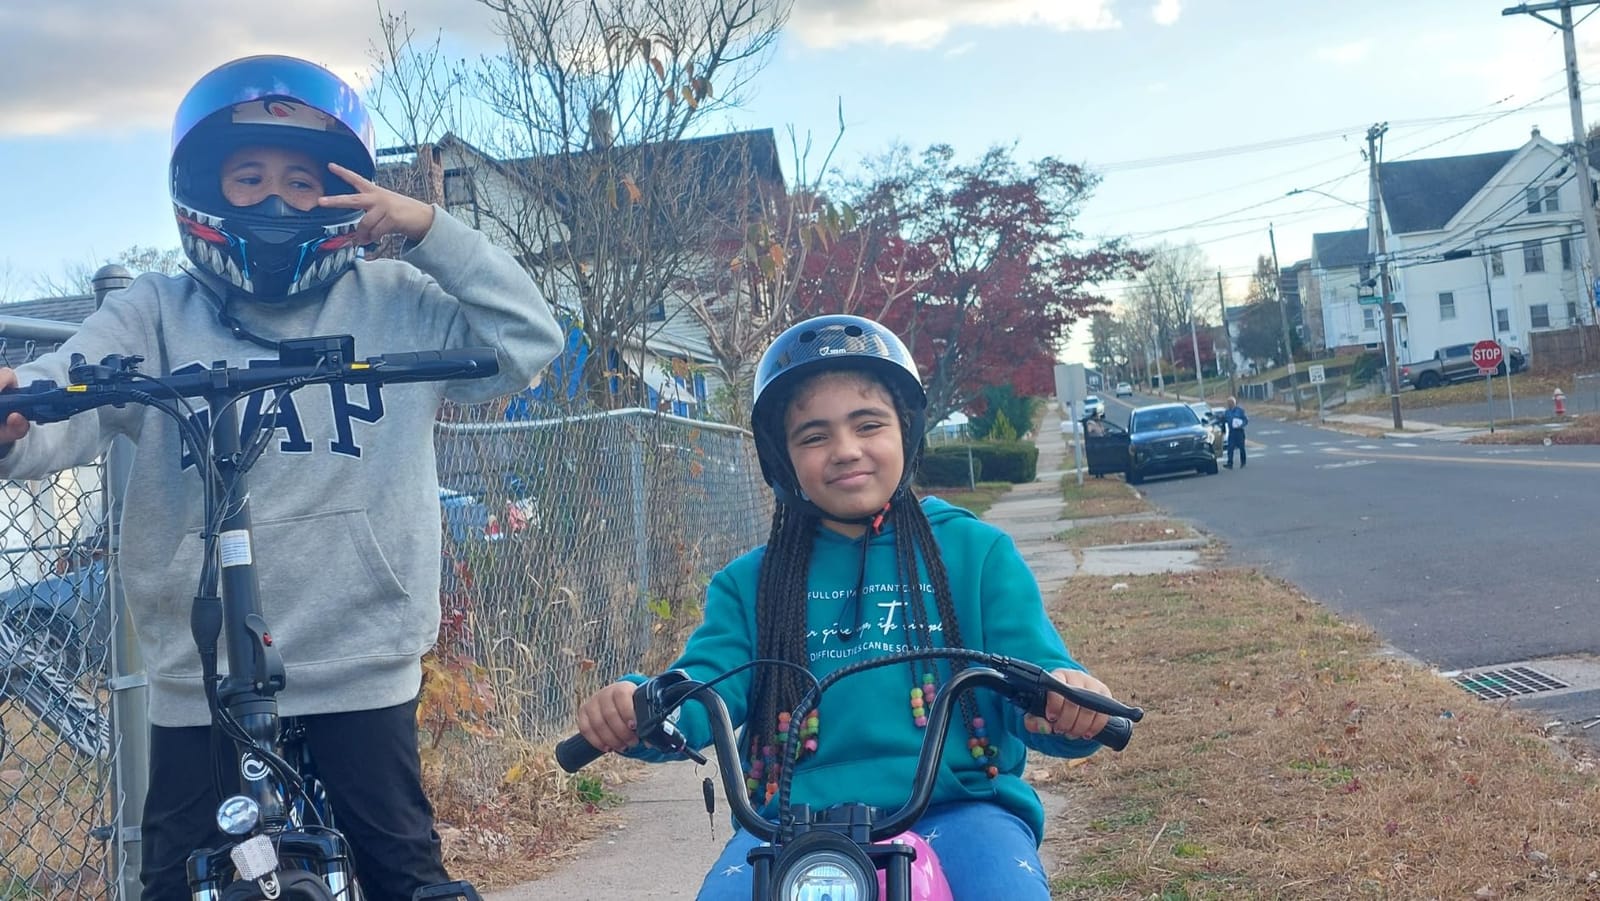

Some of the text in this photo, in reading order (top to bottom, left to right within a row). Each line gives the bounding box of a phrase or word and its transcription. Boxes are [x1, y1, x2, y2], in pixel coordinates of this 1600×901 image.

[1474, 348, 1500, 361] STOP
[1311, 374, 1323, 382] 25
[807, 591, 830, 600] FULL
[831, 590, 845, 599] OF
[810, 644, 862, 661] DIFFICULTIES
[862, 641, 881, 650] CAN
[882, 642, 894, 652] BE
